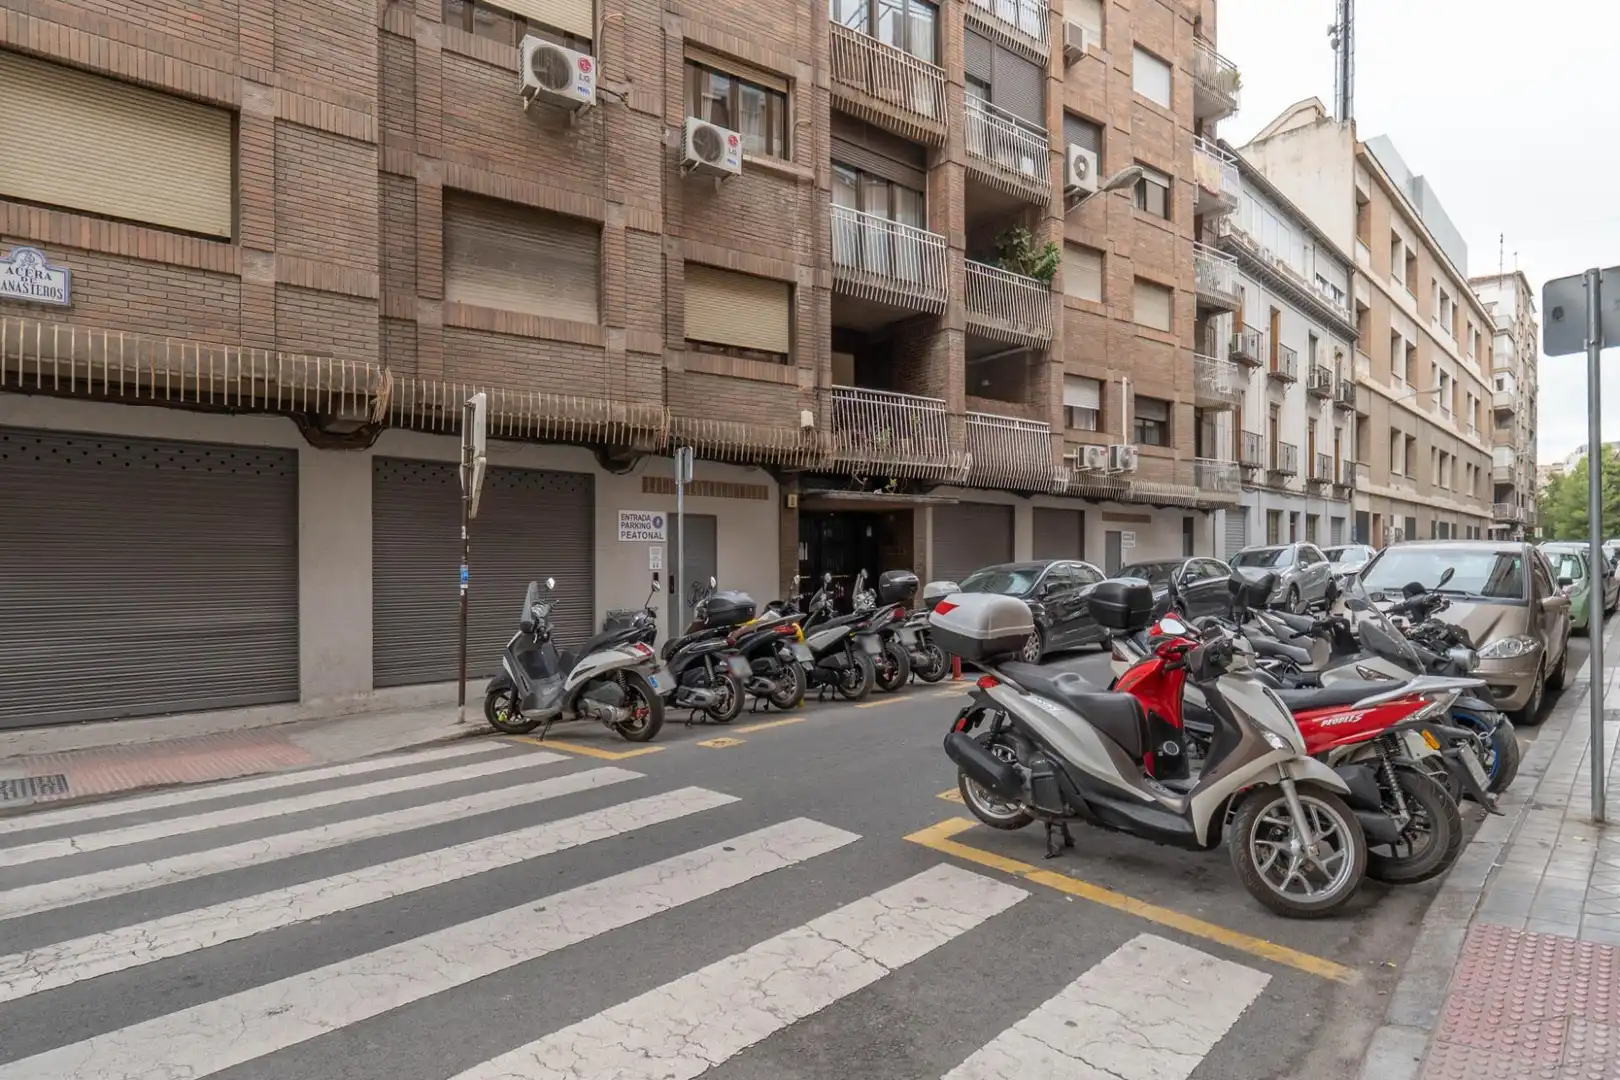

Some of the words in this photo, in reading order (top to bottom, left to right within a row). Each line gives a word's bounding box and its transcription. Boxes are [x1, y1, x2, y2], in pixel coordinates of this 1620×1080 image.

[578, 73, 590, 83] LG
[4, 266, 52, 281] ACERA
[620, 513, 651, 522] ENTRADA
[620, 521, 652, 530] PARKING
[620, 530, 664, 540] PEATONAL
